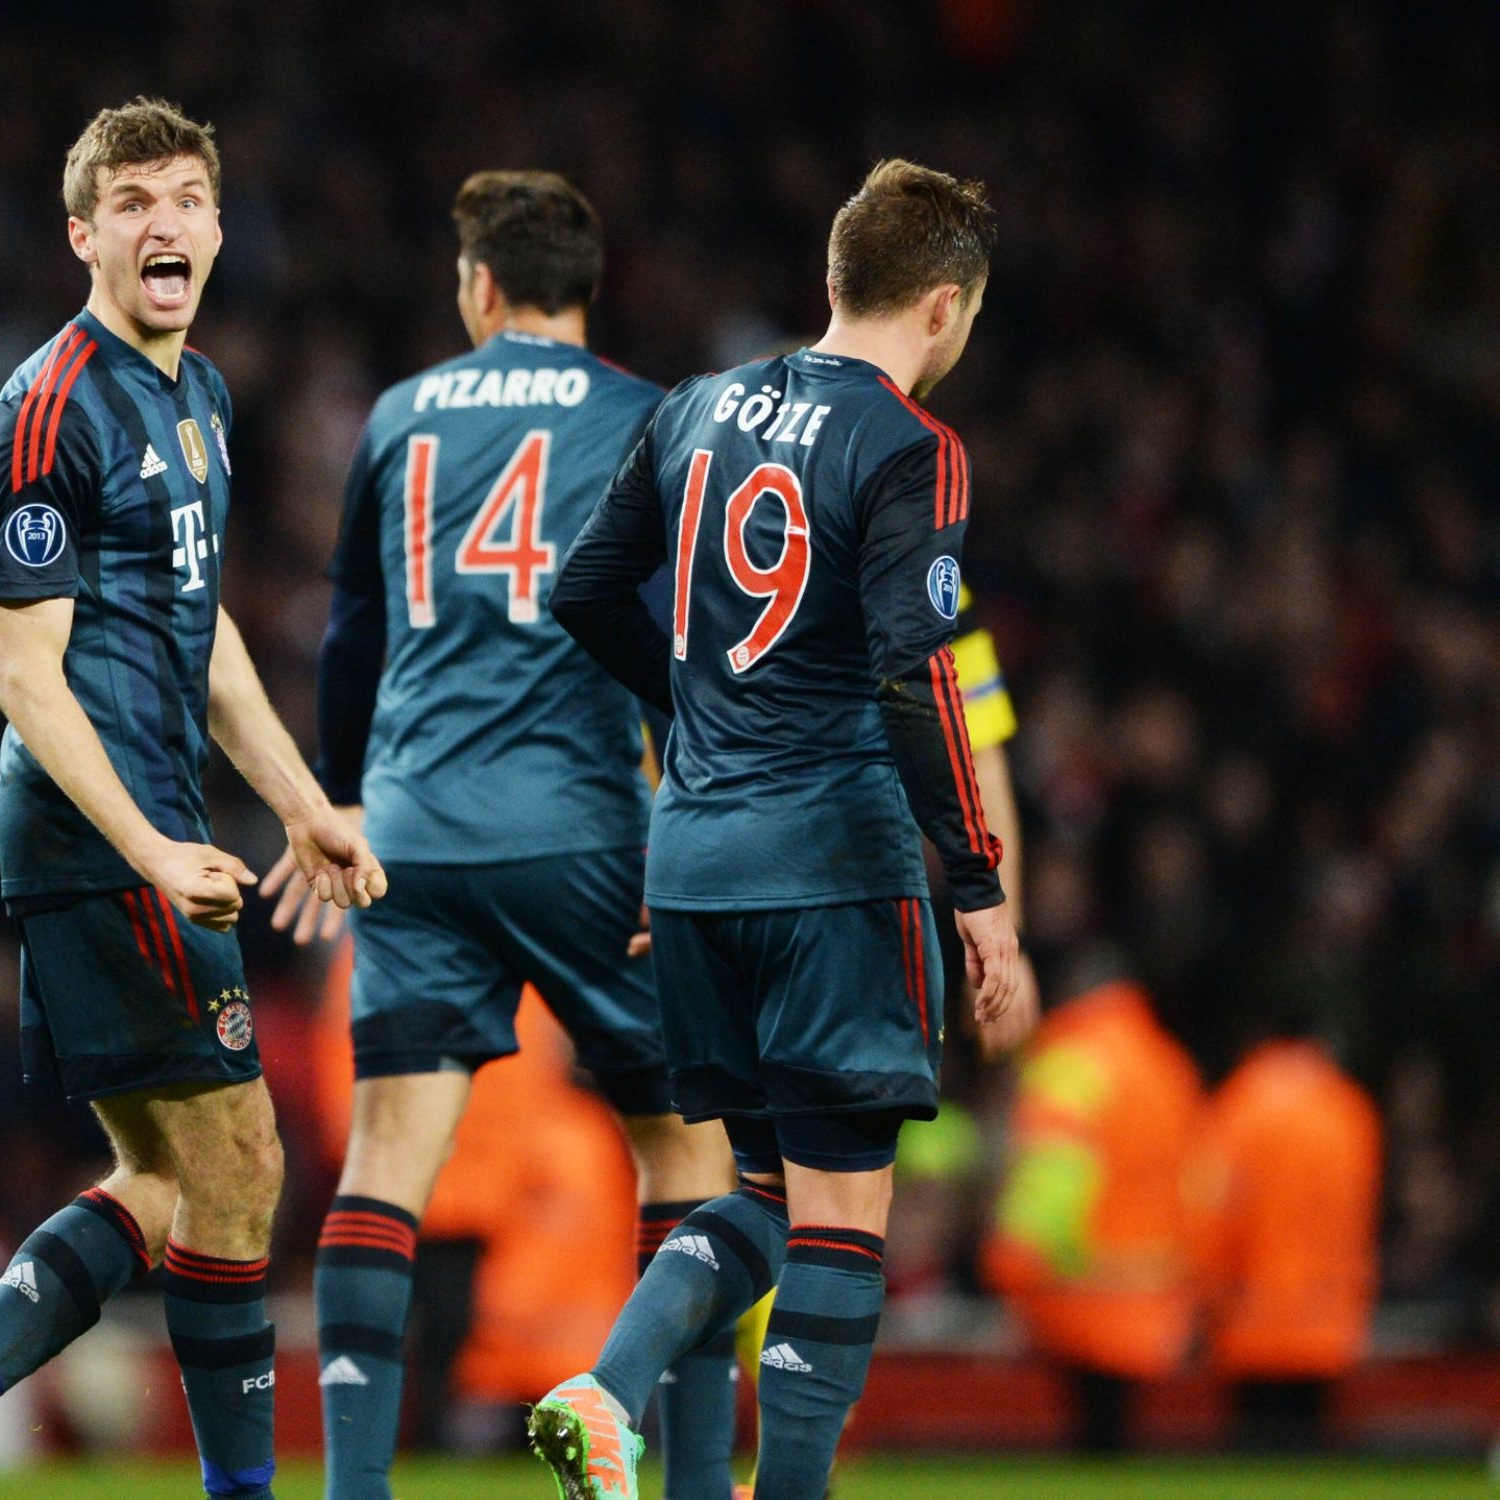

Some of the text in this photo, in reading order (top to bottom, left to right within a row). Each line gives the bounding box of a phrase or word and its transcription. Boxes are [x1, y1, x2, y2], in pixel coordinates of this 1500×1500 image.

[413, 367, 590, 413] PIZARRO
[713, 382, 831, 446] GÖTZE
[27, 531, 47, 541] 2013
[404, 429, 557, 629] 14
[674, 448, 811, 674] 19
[658, 1243, 720, 1271] adidas
